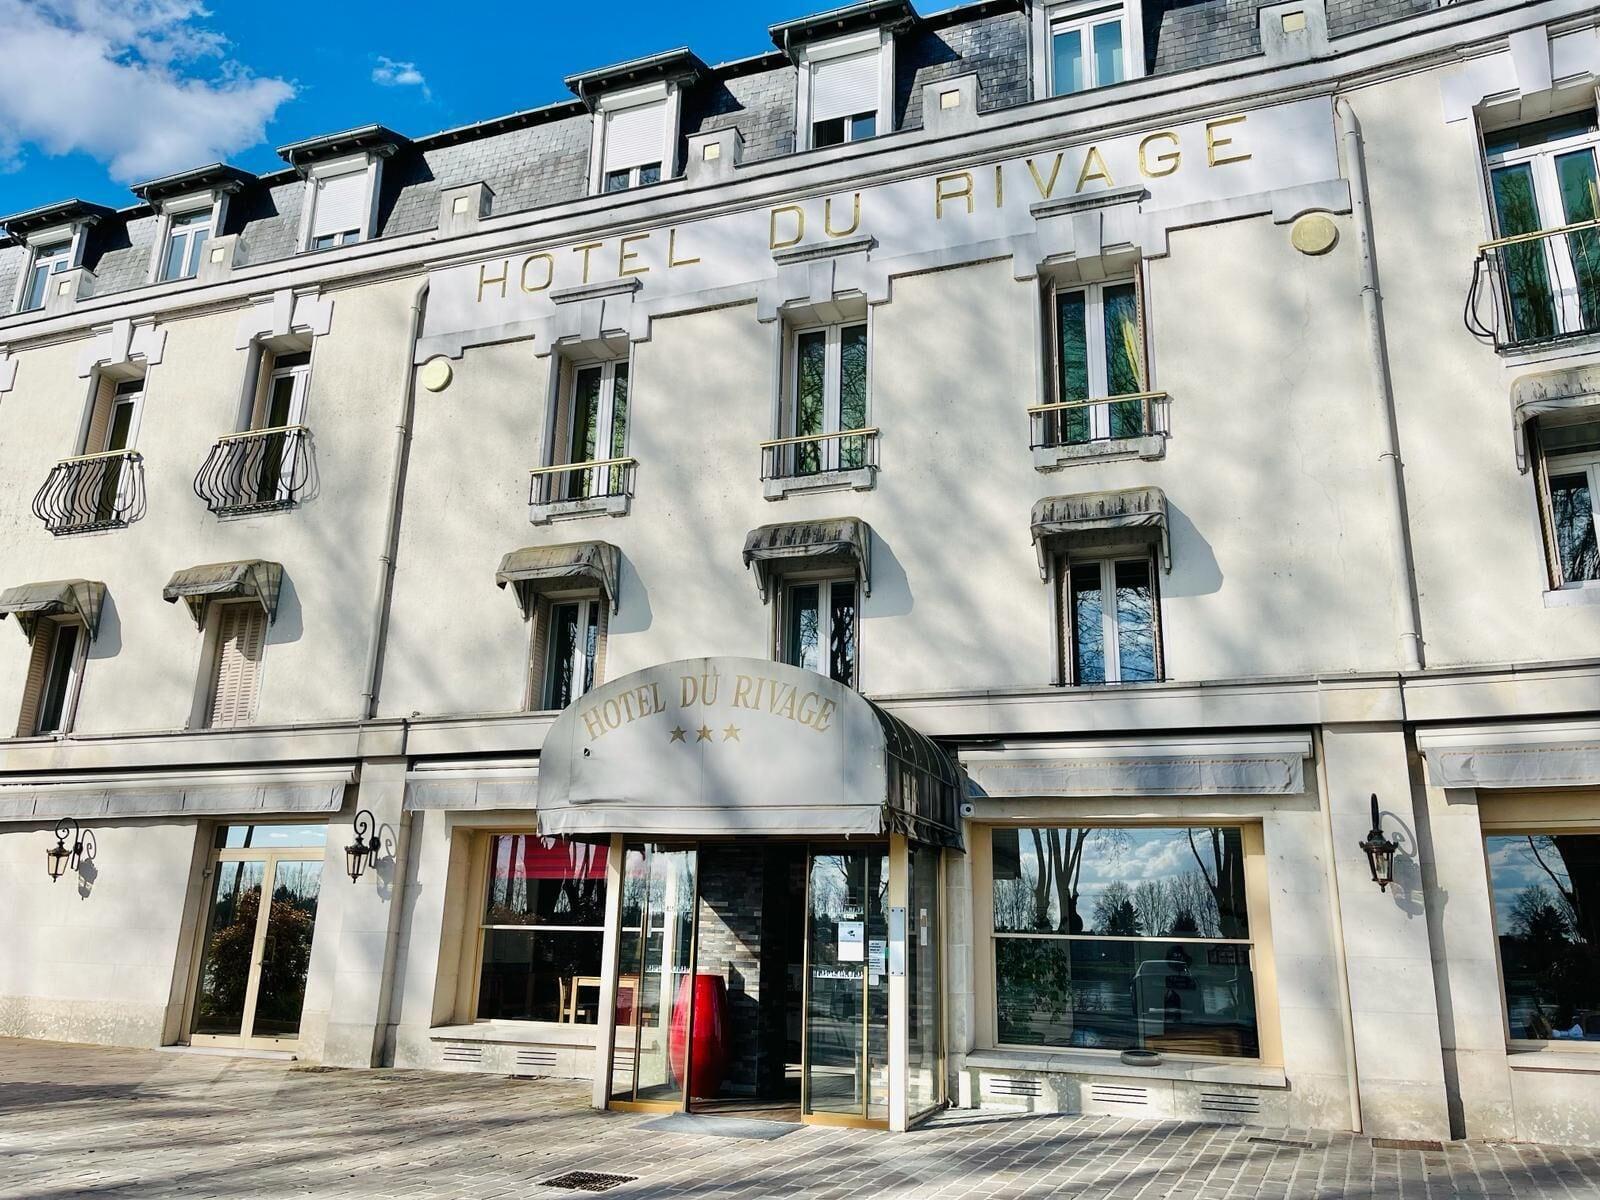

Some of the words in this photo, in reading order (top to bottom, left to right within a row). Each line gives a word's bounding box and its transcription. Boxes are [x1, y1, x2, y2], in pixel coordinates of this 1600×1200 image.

[478, 228, 701, 303] HOTEL
[769, 192, 861, 250] DU
[935, 115, 1253, 220] RIVAGE
[580, 681, 666, 742] HOTEL
[680, 673, 720, 708] DU
[733, 674, 838, 733] RIVAGE
